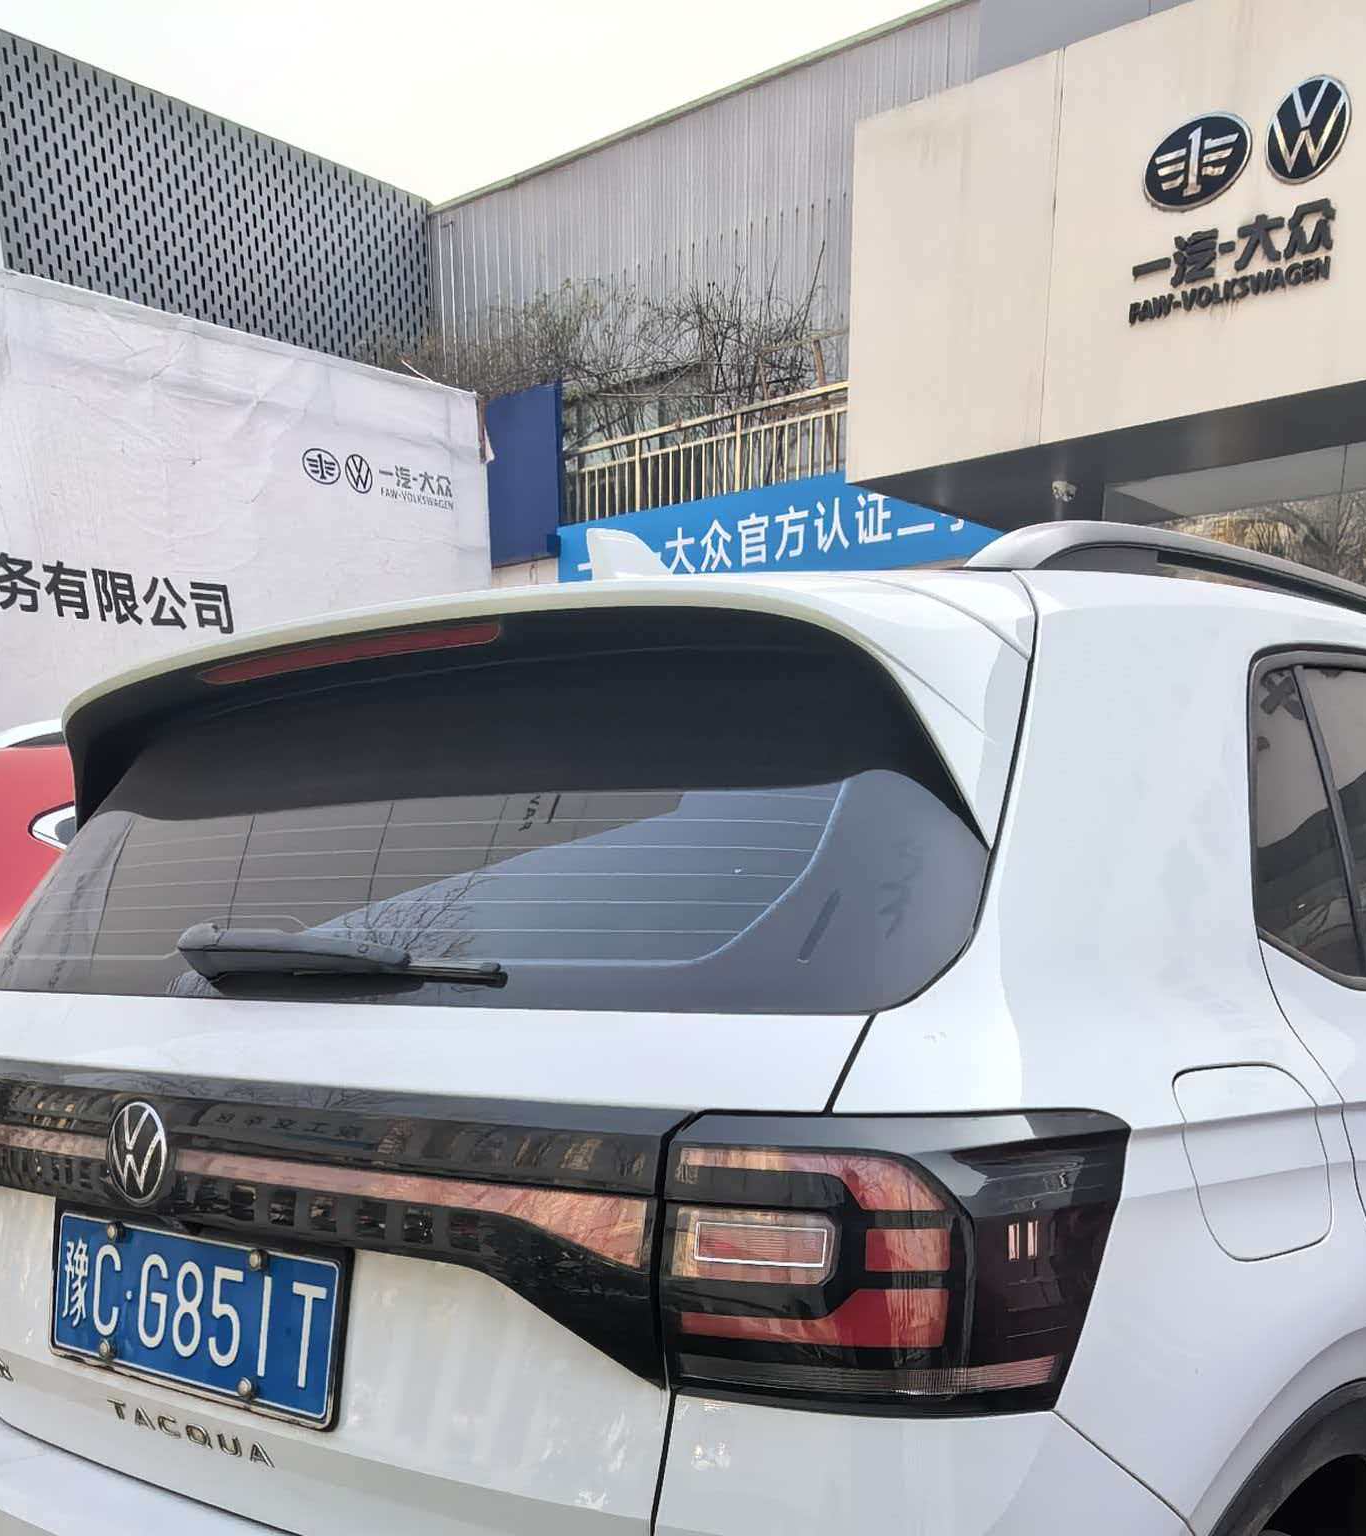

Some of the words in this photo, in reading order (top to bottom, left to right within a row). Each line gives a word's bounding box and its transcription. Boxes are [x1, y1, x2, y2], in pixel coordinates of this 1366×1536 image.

[1131, 198, 1337, 288] 一汽-大众
[1128, 255, 1332, 326] FAW-VOLKSWAGEN
[379, 465, 453, 498] 一汽-大众
[107, 1398, 276, 1469] TACQUA
